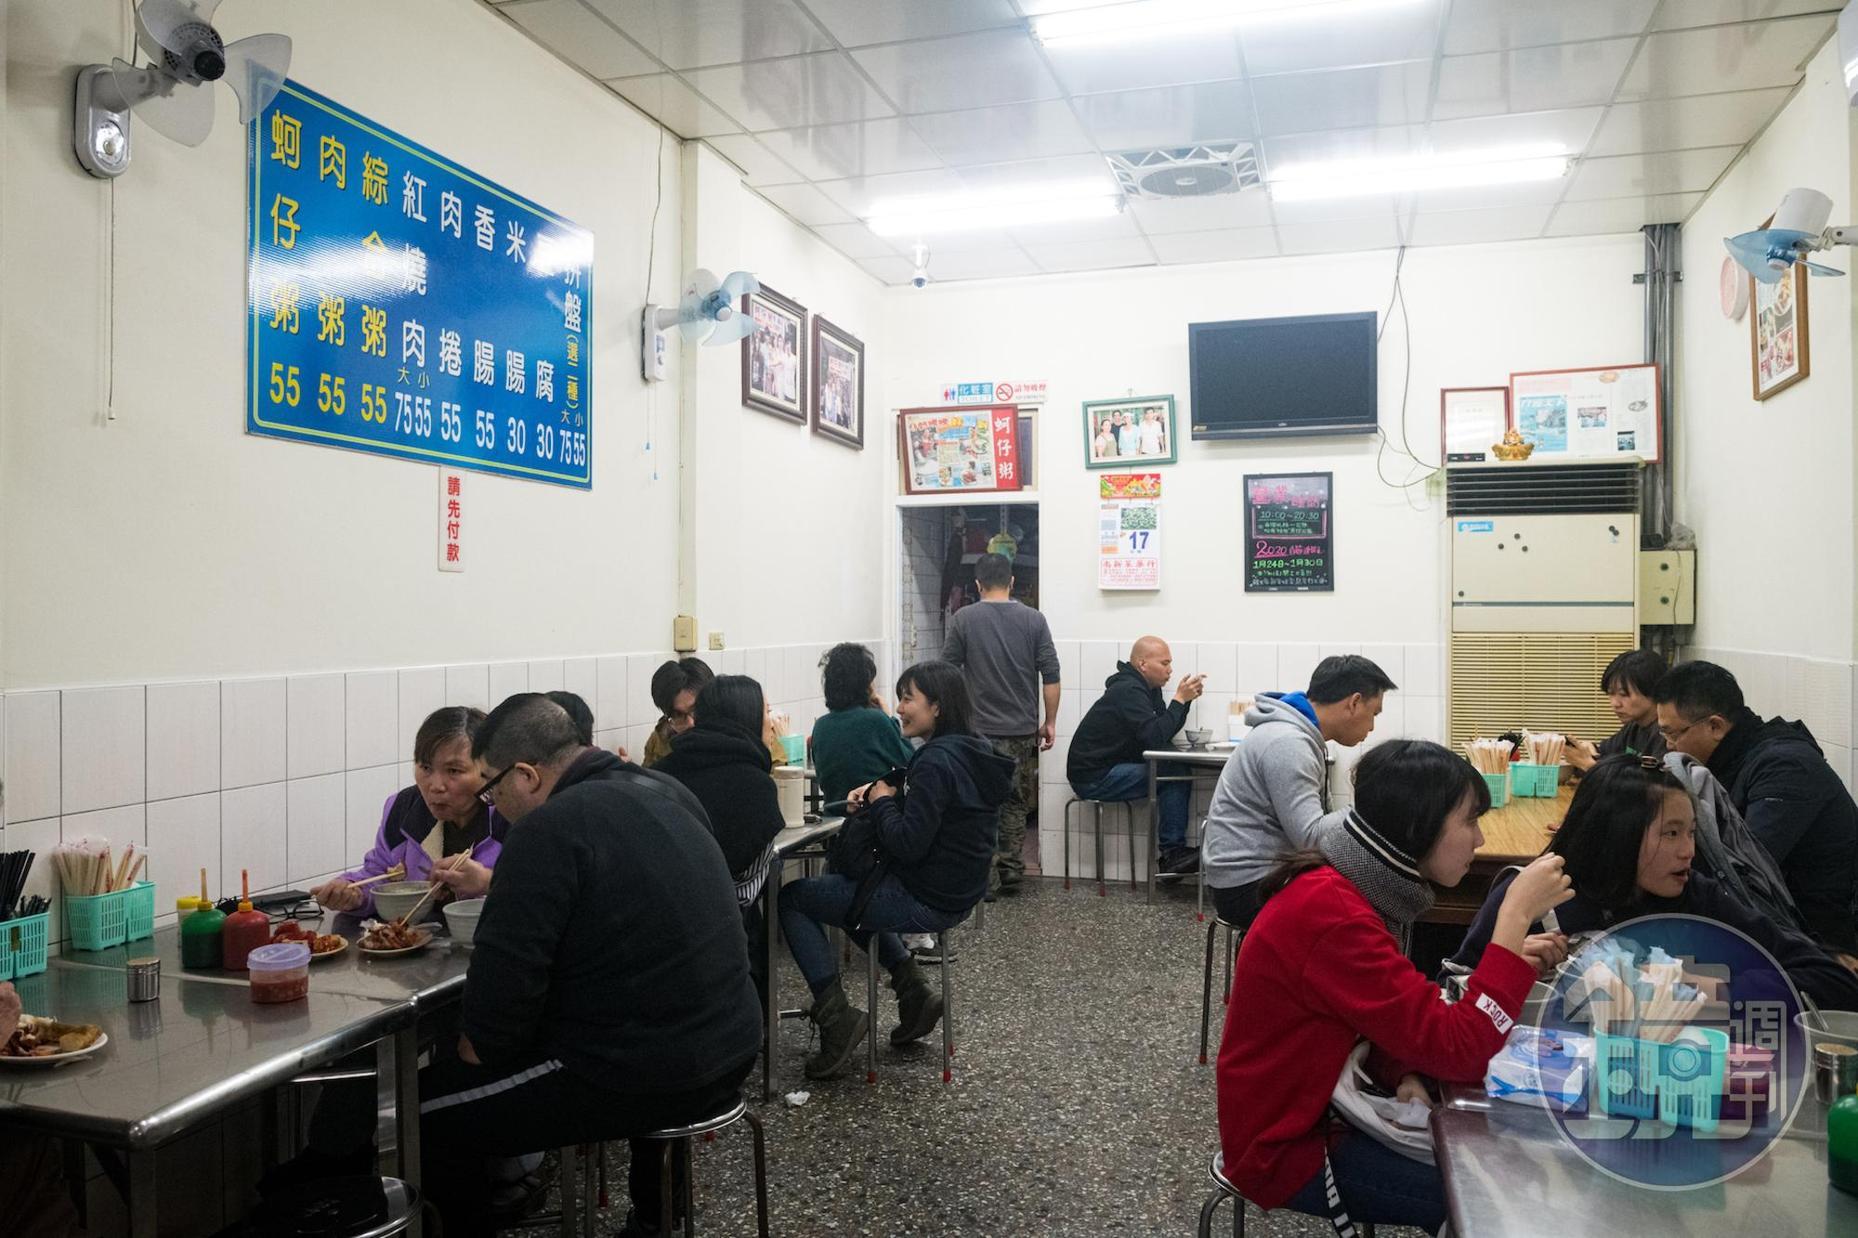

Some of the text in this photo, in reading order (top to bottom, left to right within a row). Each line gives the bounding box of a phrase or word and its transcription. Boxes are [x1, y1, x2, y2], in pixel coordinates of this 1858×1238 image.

[269, 109, 302, 334] 蚵仔粥
[317, 134, 347, 348] 肉粥
[401, 169, 428, 369] 紅燒肉
[439, 190, 463, 378] 肉捲
[473, 203, 496, 386] 香腸
[505, 220, 527, 395] 米腸
[269, 362, 301, 408] 55
[317, 372, 346, 416] 55
[360, 383, 387, 425] 55
[440, 400, 462, 443] 55
[475, 409, 495, 450] 55
[507, 417, 526, 454] 30
[536, 423, 554, 460] 30
[994, 416, 1014, 480] 蚵仔粥
[446, 476, 461, 562] 請先付款
[1129, 531, 1150, 550] 17
[1482, 998, 1508, 1028] ROCK
